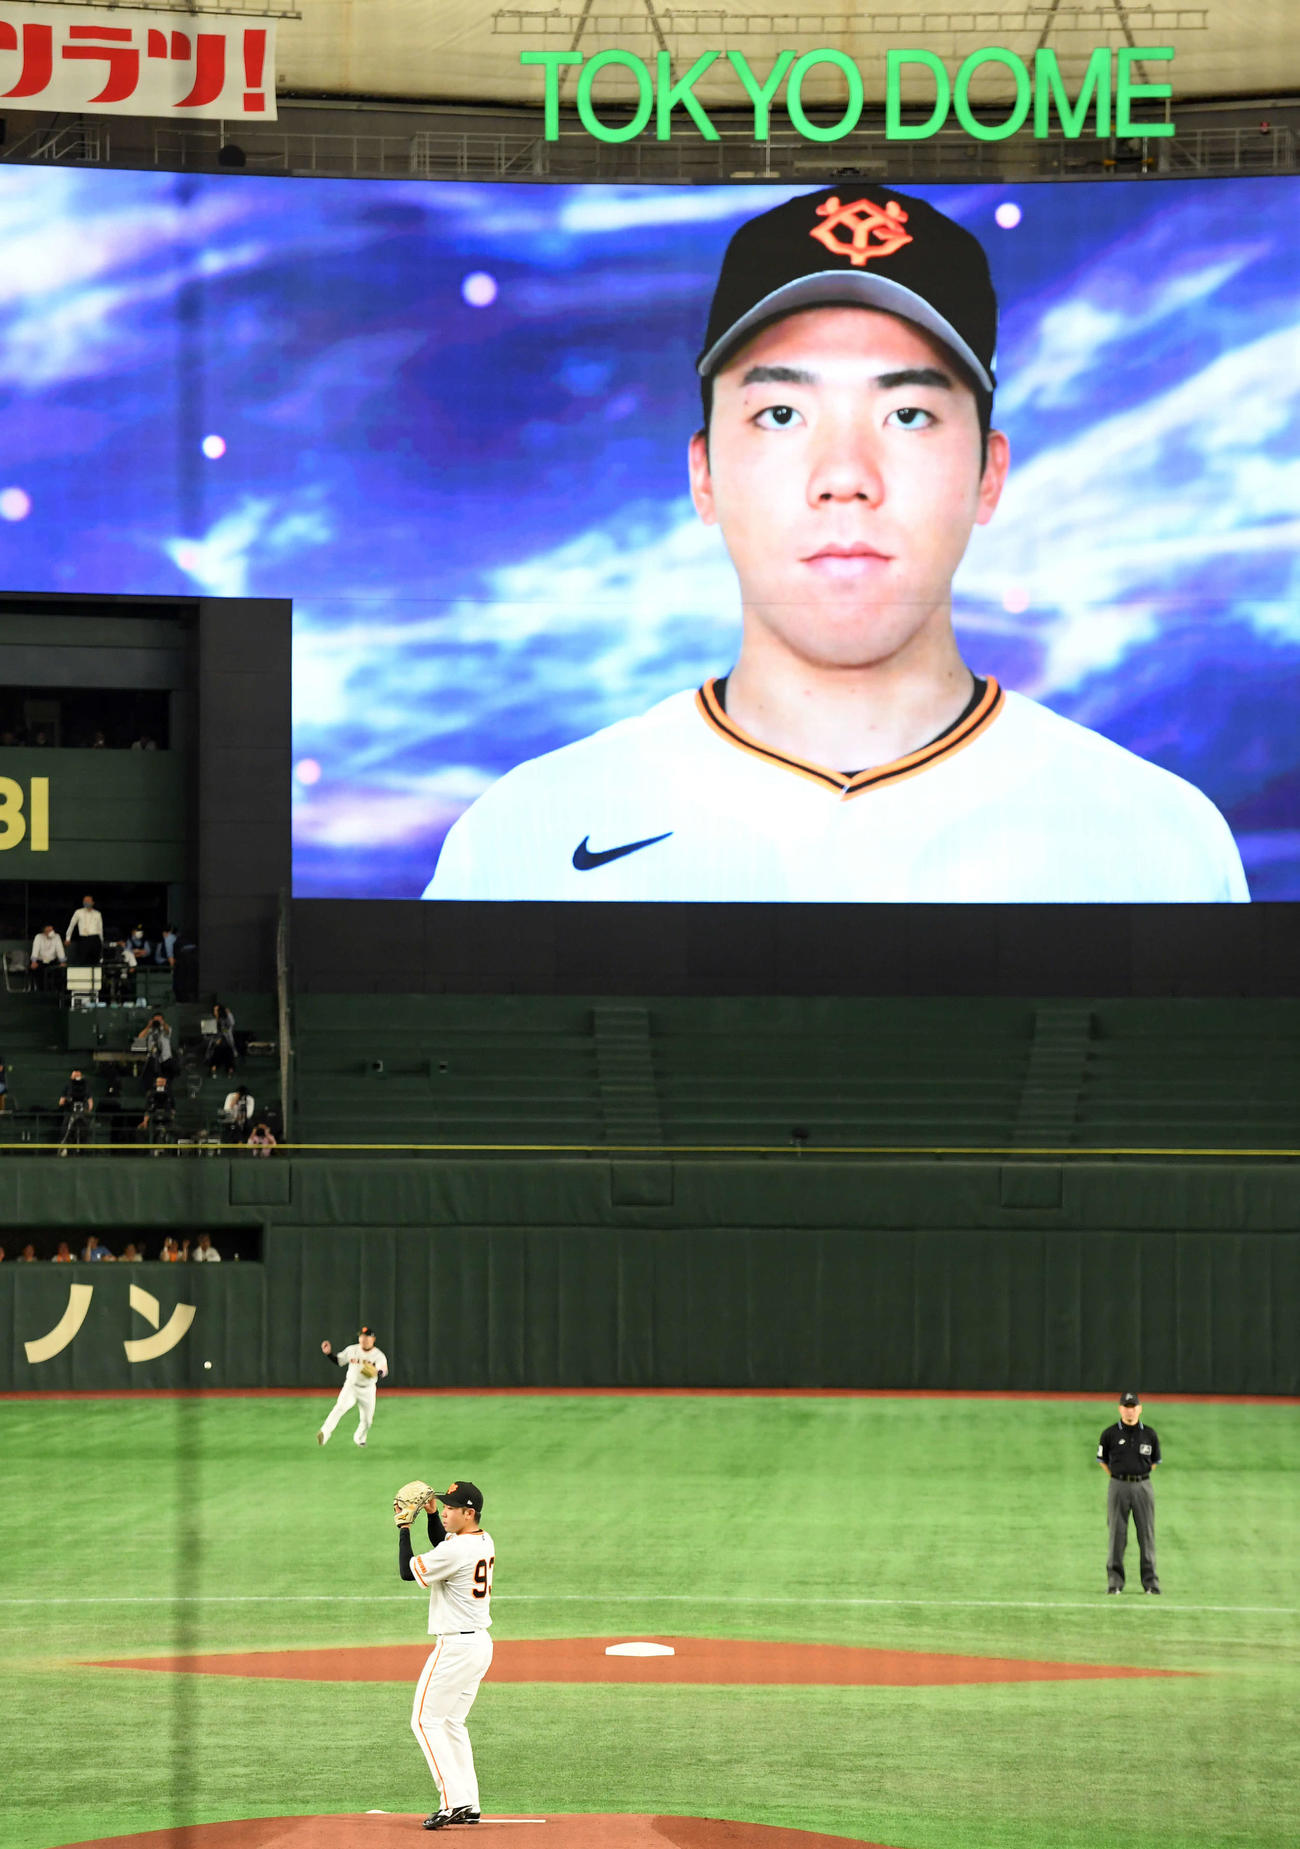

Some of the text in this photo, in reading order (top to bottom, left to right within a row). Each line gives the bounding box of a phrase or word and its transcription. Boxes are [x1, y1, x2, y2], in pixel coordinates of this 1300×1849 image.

[520, 46, 1175, 142] TOKYO DOME
[24, 1283, 197, 1363] ノン
